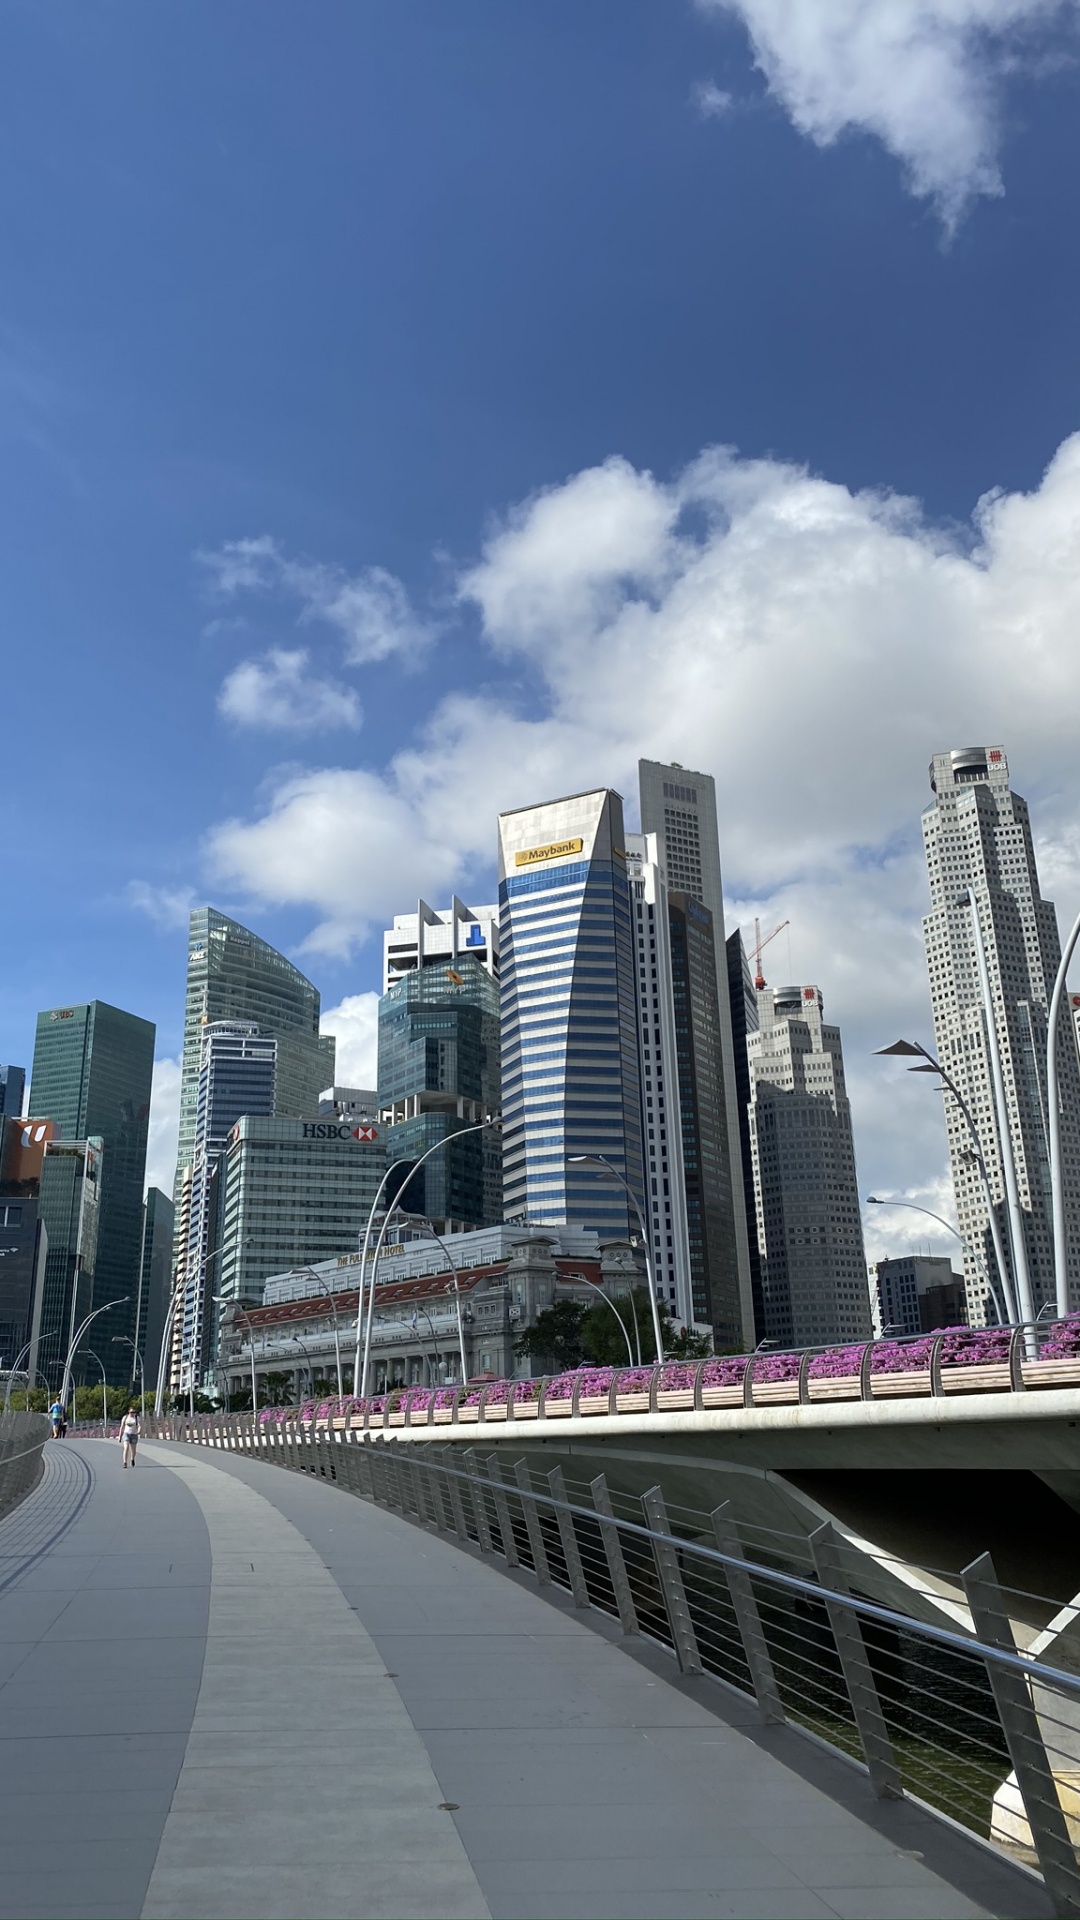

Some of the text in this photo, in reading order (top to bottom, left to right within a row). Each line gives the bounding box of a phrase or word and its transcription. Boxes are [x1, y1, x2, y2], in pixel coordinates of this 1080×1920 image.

[988, 762, 1006, 771] UOB
[528, 842, 575, 859] Maybank
[302, 1123, 351, 1140] HSBC
[337, 1256, 348, 1266] THE
[384, 1244, 405, 1256] HOTEL
